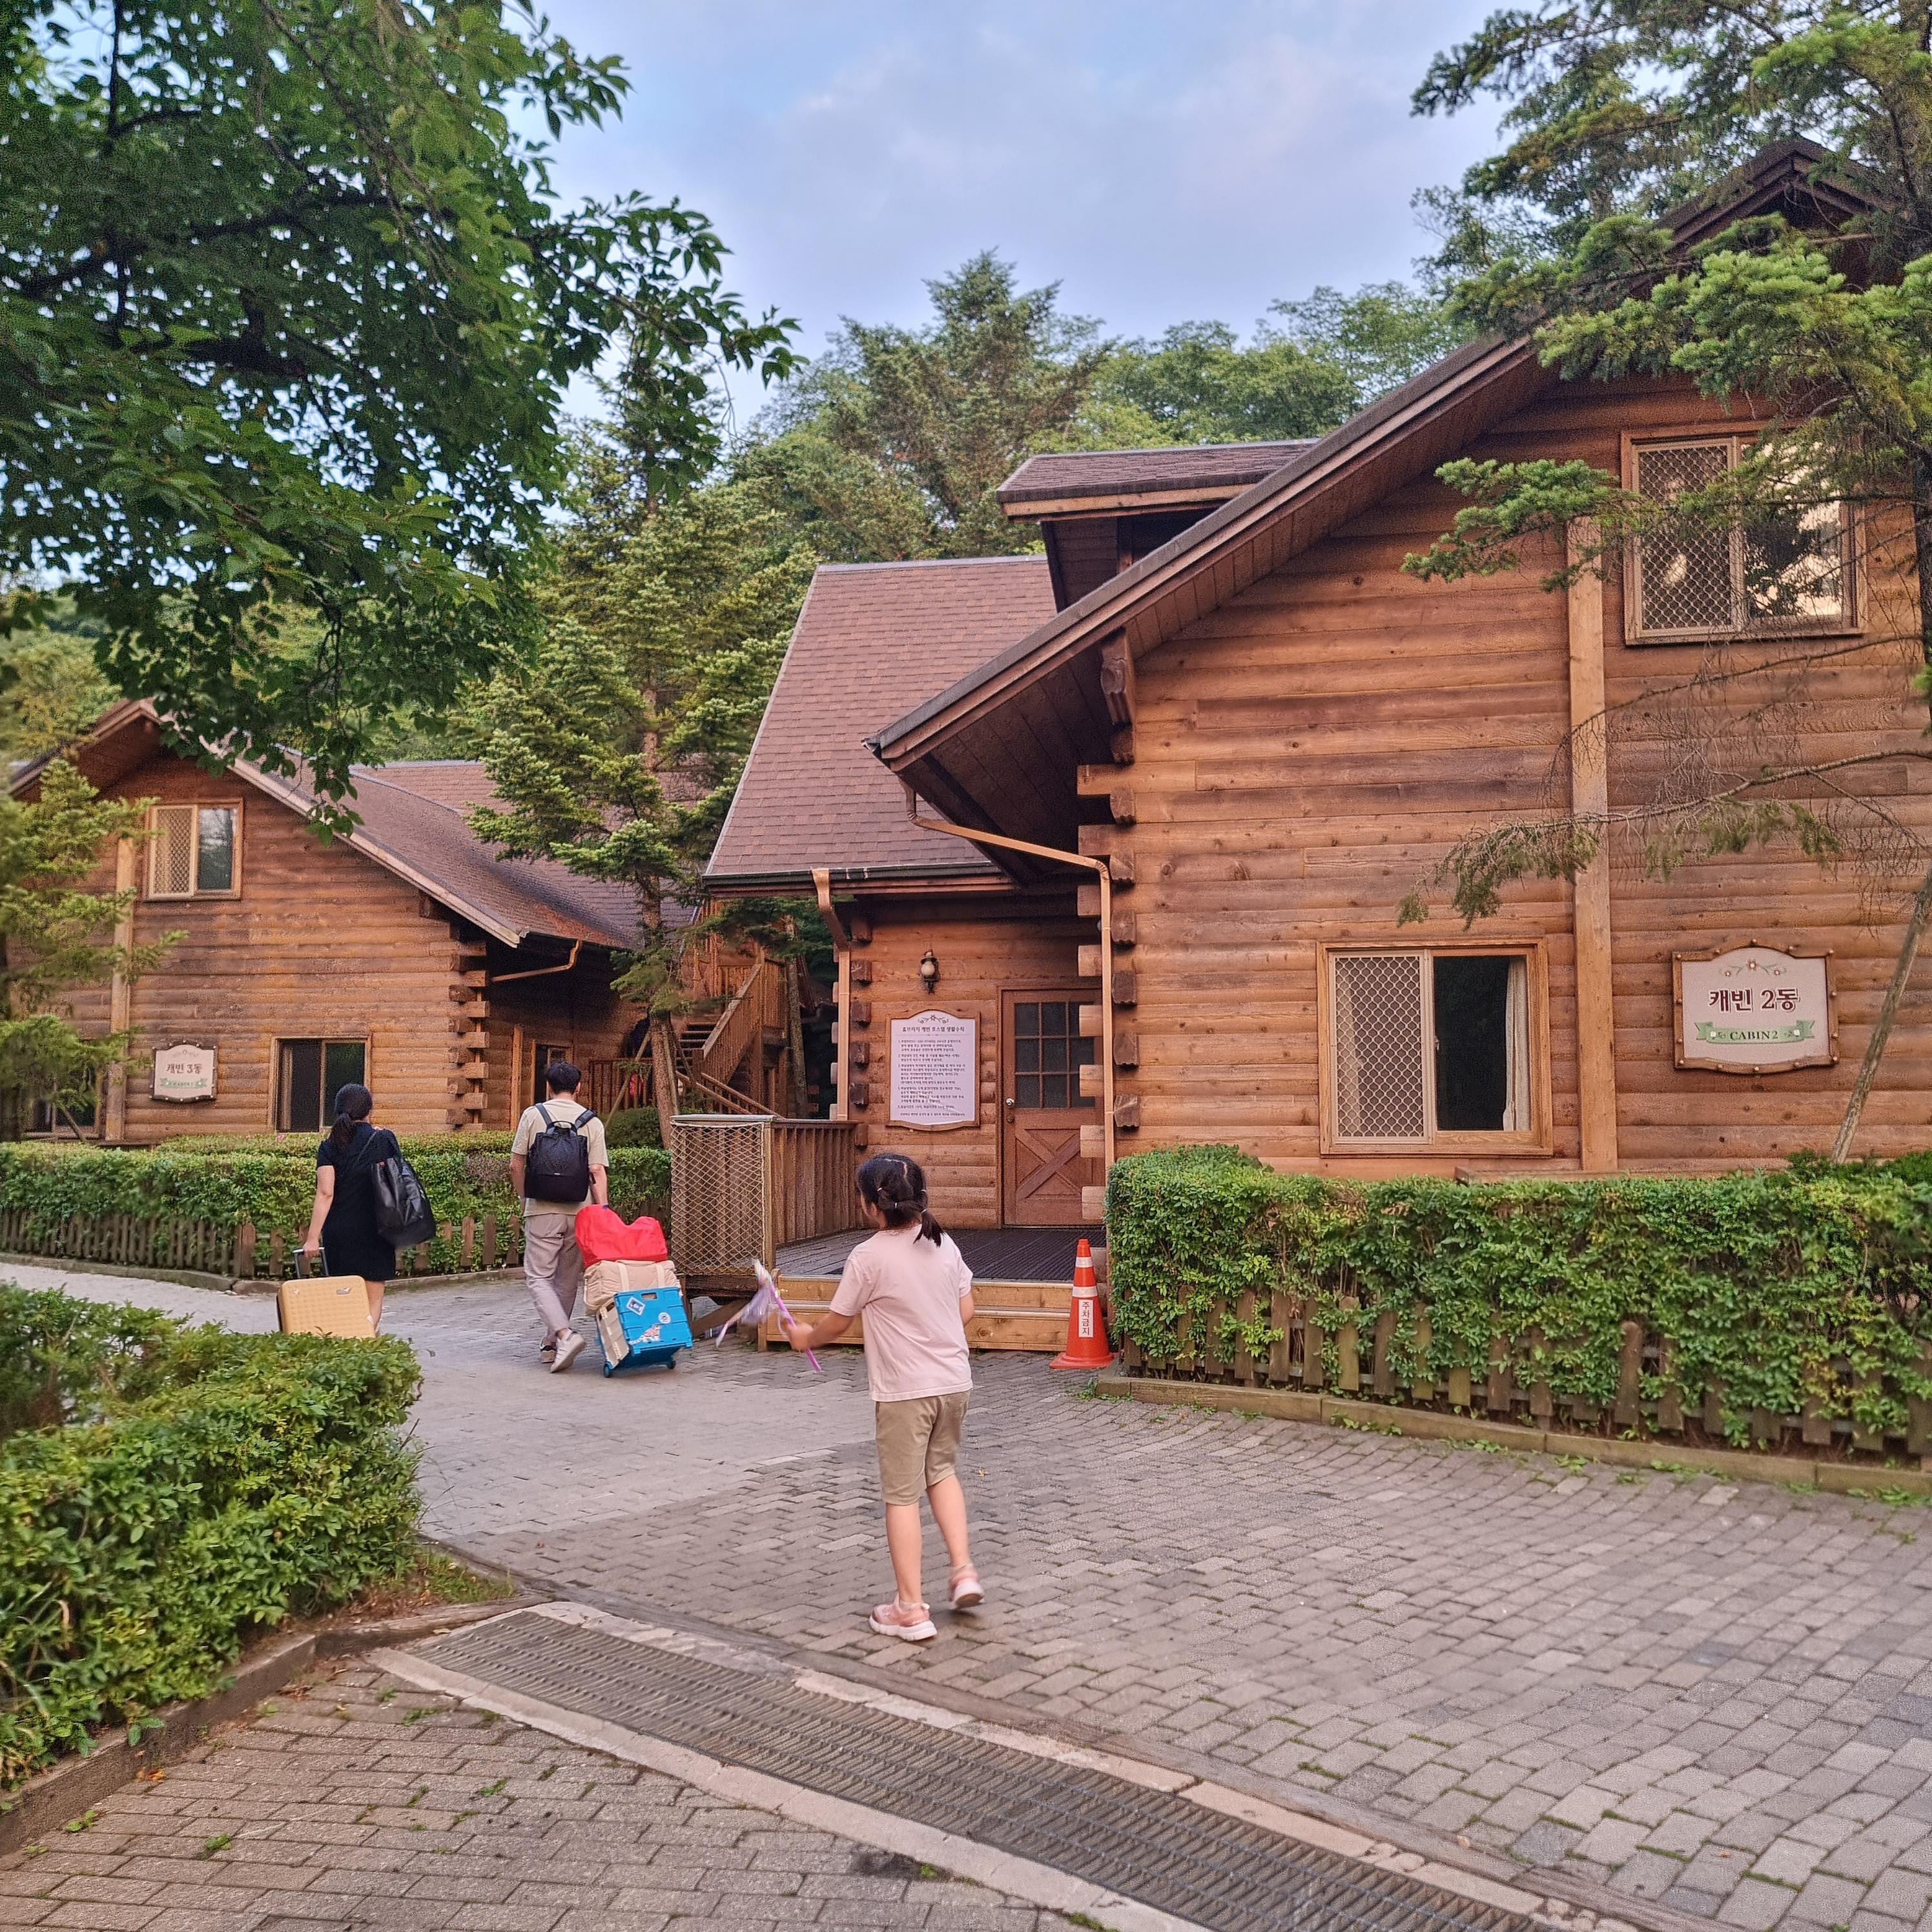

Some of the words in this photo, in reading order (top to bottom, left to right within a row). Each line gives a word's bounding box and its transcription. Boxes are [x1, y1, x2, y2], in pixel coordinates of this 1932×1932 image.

[1709, 989, 1752, 1012] 캐빈
[1761, 988, 1799, 1011] 2동
[187, 1063, 202, 1074] 3동
[1082, 1301, 1090, 1336] 주차금지
